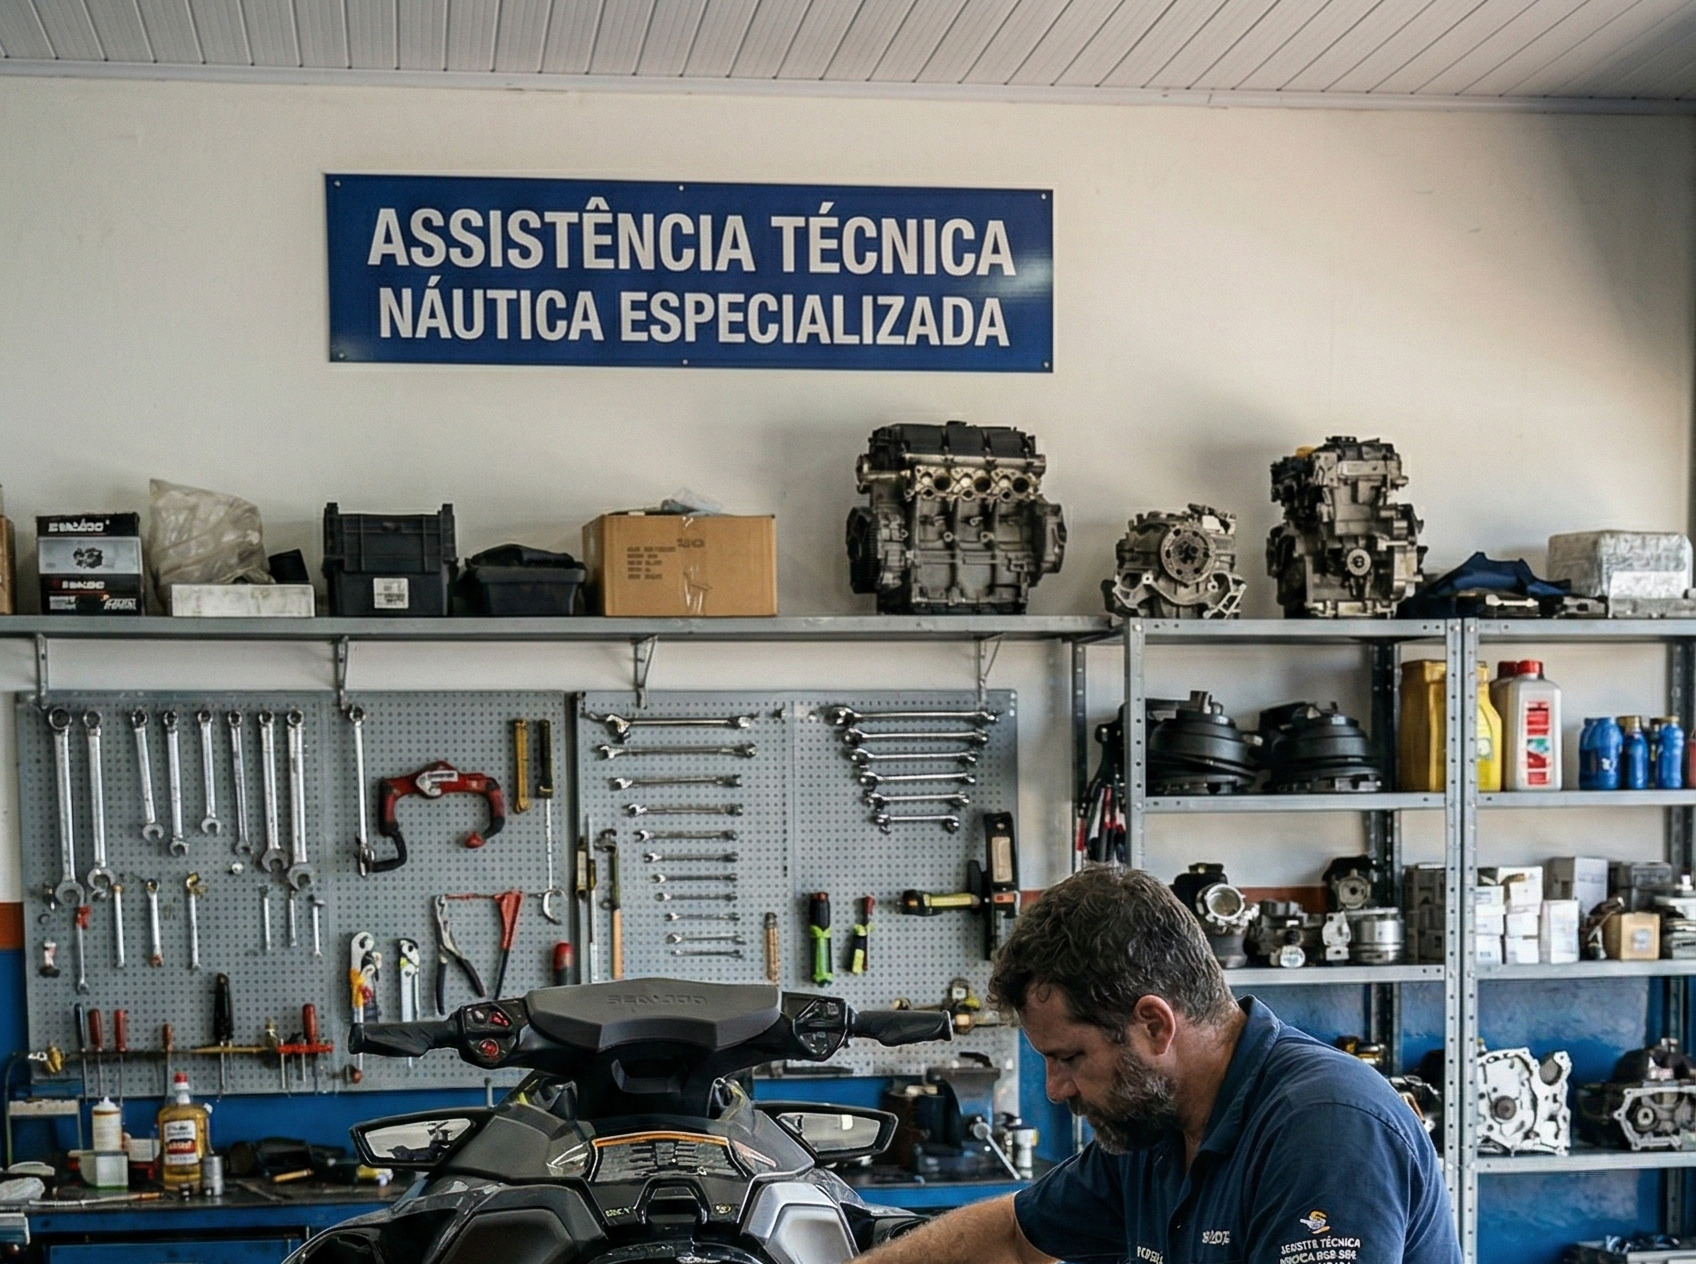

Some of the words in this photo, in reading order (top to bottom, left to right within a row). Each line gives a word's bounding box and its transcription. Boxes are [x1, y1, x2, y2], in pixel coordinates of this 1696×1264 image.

[367, 196, 756, 273] ASSISTÊNCIA
[770, 201, 1017, 277] TÉCNICA
[378, 275, 605, 342] NÁUTICA
[620, 290, 1011, 348] ESPECIALIZADA
[1320, 1235, 1361, 1248] TÉCNICA
